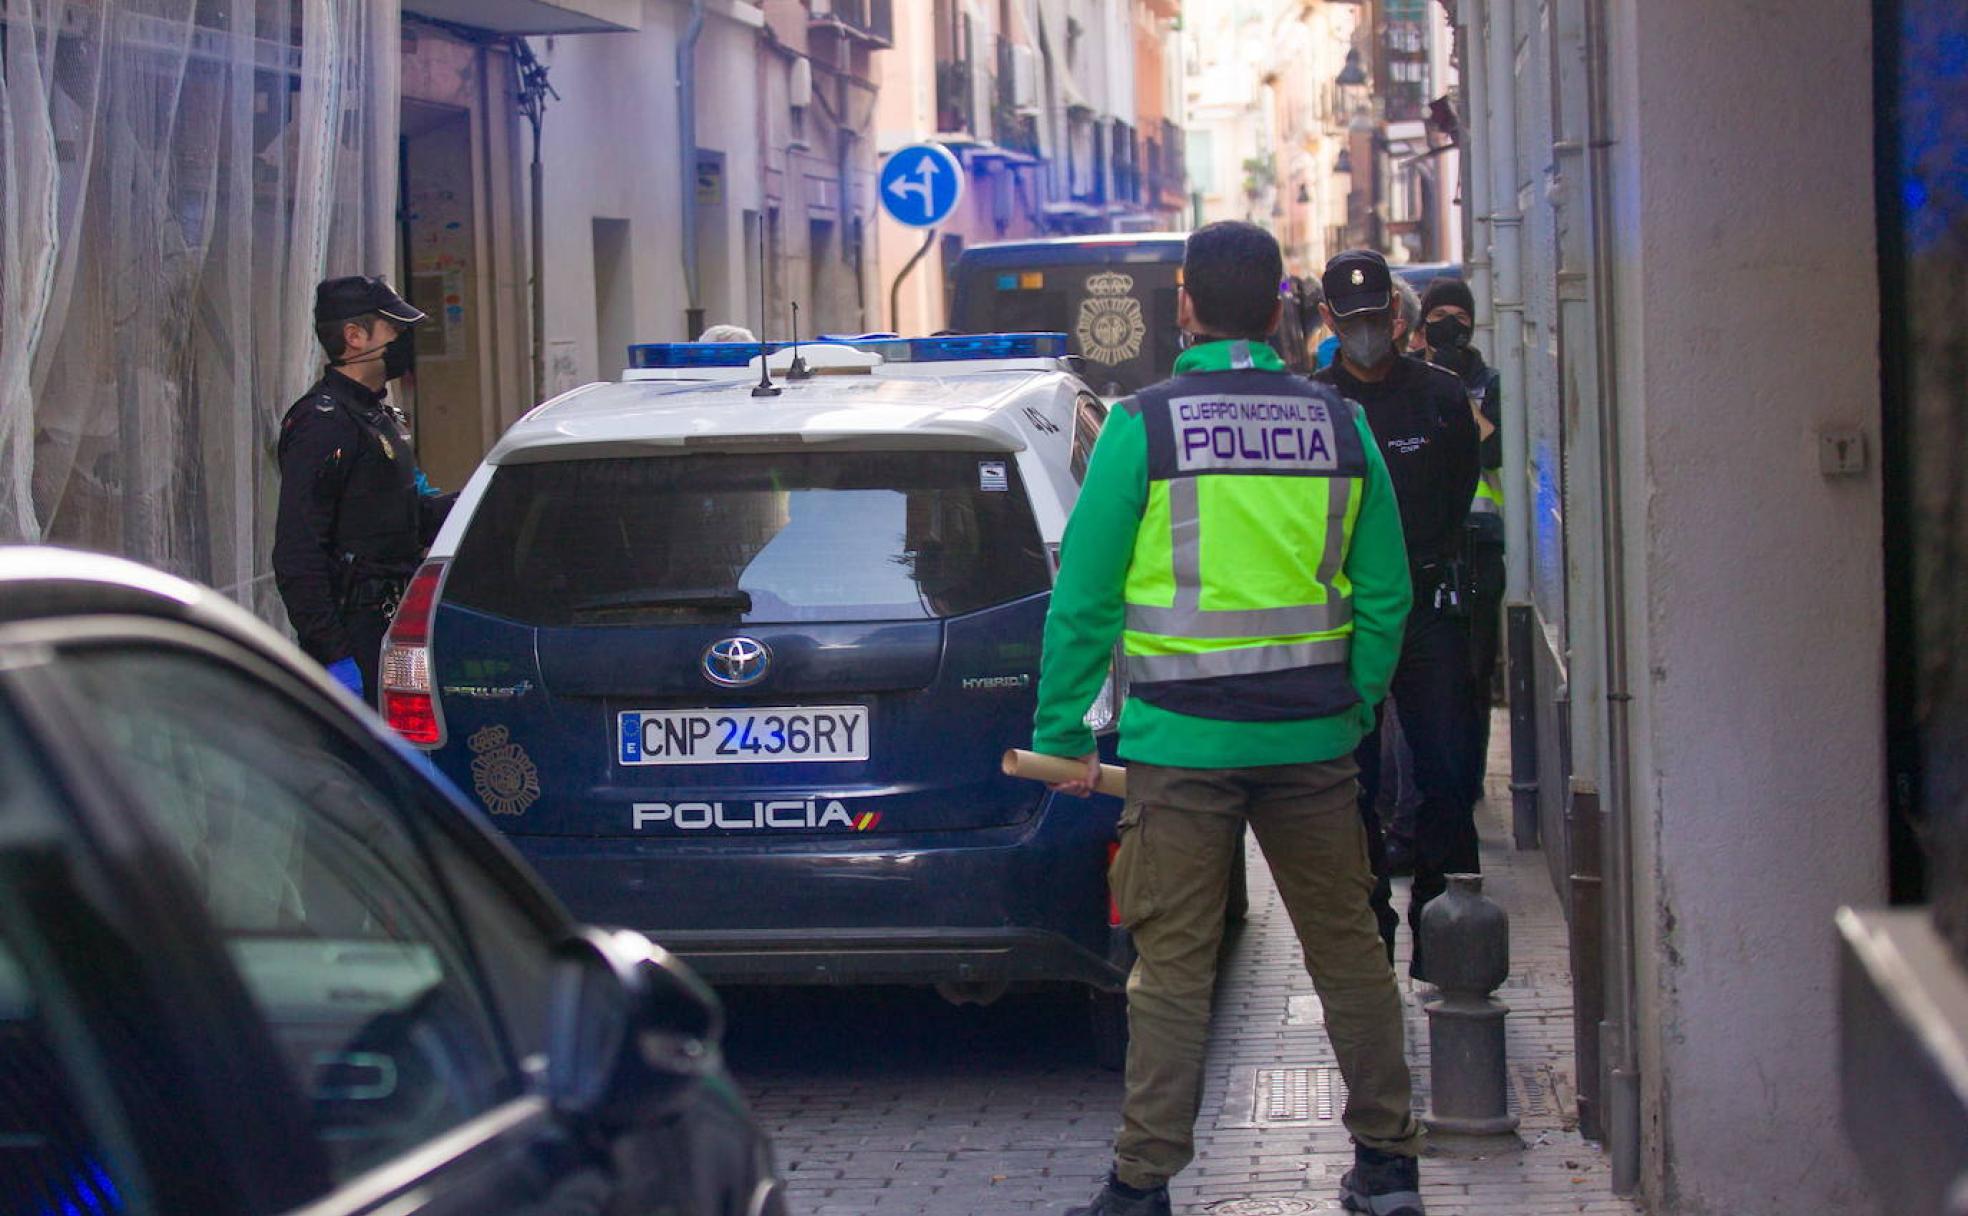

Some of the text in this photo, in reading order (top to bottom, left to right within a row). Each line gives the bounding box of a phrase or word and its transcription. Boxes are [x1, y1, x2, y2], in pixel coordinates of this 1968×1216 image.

[1179, 402, 1327, 422] CUERPO NACIONAL DE
[1183, 425, 1331, 462] POLICIA
[626, 742, 637, 754] E
